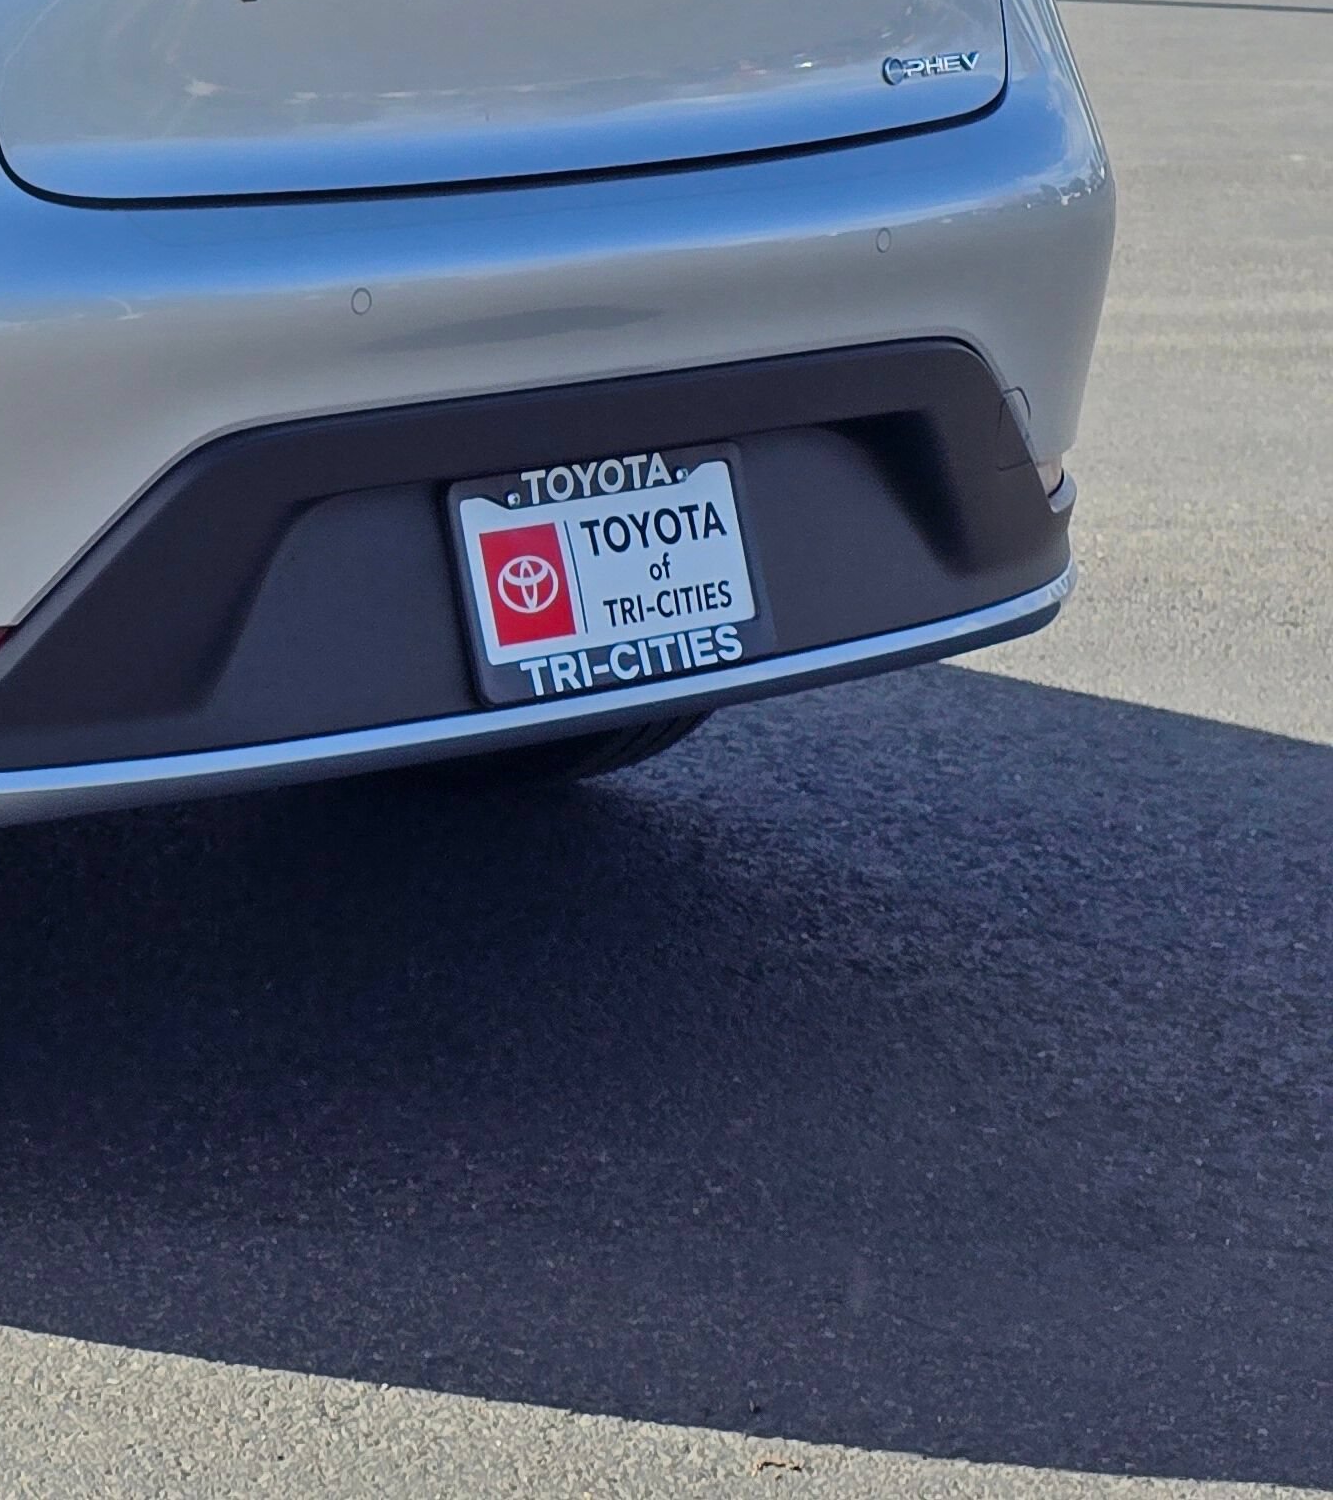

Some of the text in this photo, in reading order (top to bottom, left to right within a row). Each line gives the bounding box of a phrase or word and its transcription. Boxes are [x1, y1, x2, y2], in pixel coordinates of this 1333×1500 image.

[904, 51, 980, 77] PHEV
[520, 452, 673, 506] TOYOTA
[580, 501, 728, 557] TOYOTA
[649, 553, 672, 582] of
[603, 580, 733, 628] TRI-CITIES
[520, 625, 744, 697] TRI-CITIES
